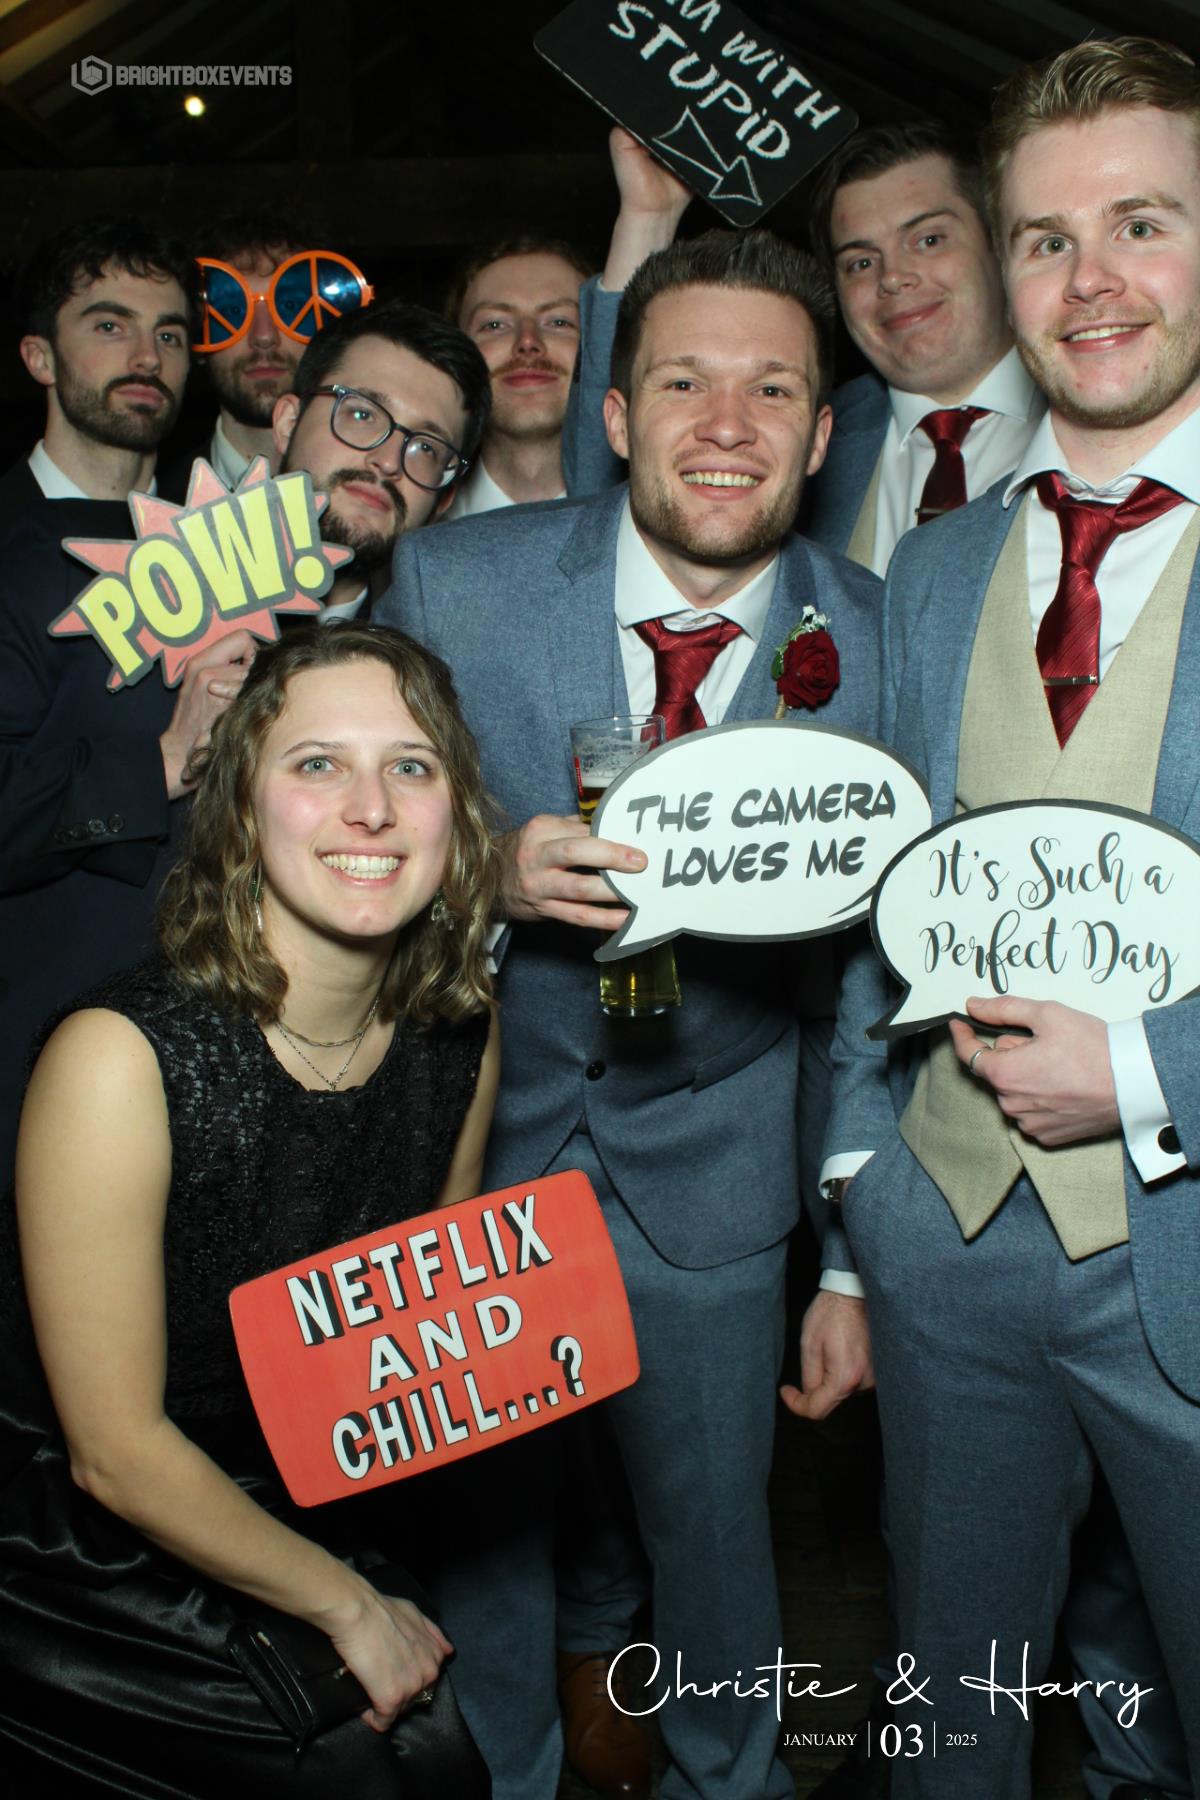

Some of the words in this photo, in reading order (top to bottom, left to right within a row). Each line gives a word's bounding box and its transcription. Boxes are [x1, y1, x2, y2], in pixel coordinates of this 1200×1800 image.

[76, 474, 326, 677] POW!
[627, 791, 714, 834] THE
[731, 780, 896, 828] CAMERA
[662, 841, 790, 888] LOVES
[805, 836, 867, 878] ME
[929, 839, 1010, 901] It's
[1017, 832, 1134, 910] Such
[1144, 865, 1175, 894] a
[918, 909, 1068, 995] Perfect
[1072, 916, 1180, 1003] Day
[285, 1193, 553, 1346] NETFLIX
[369, 1295, 523, 1393] AND
